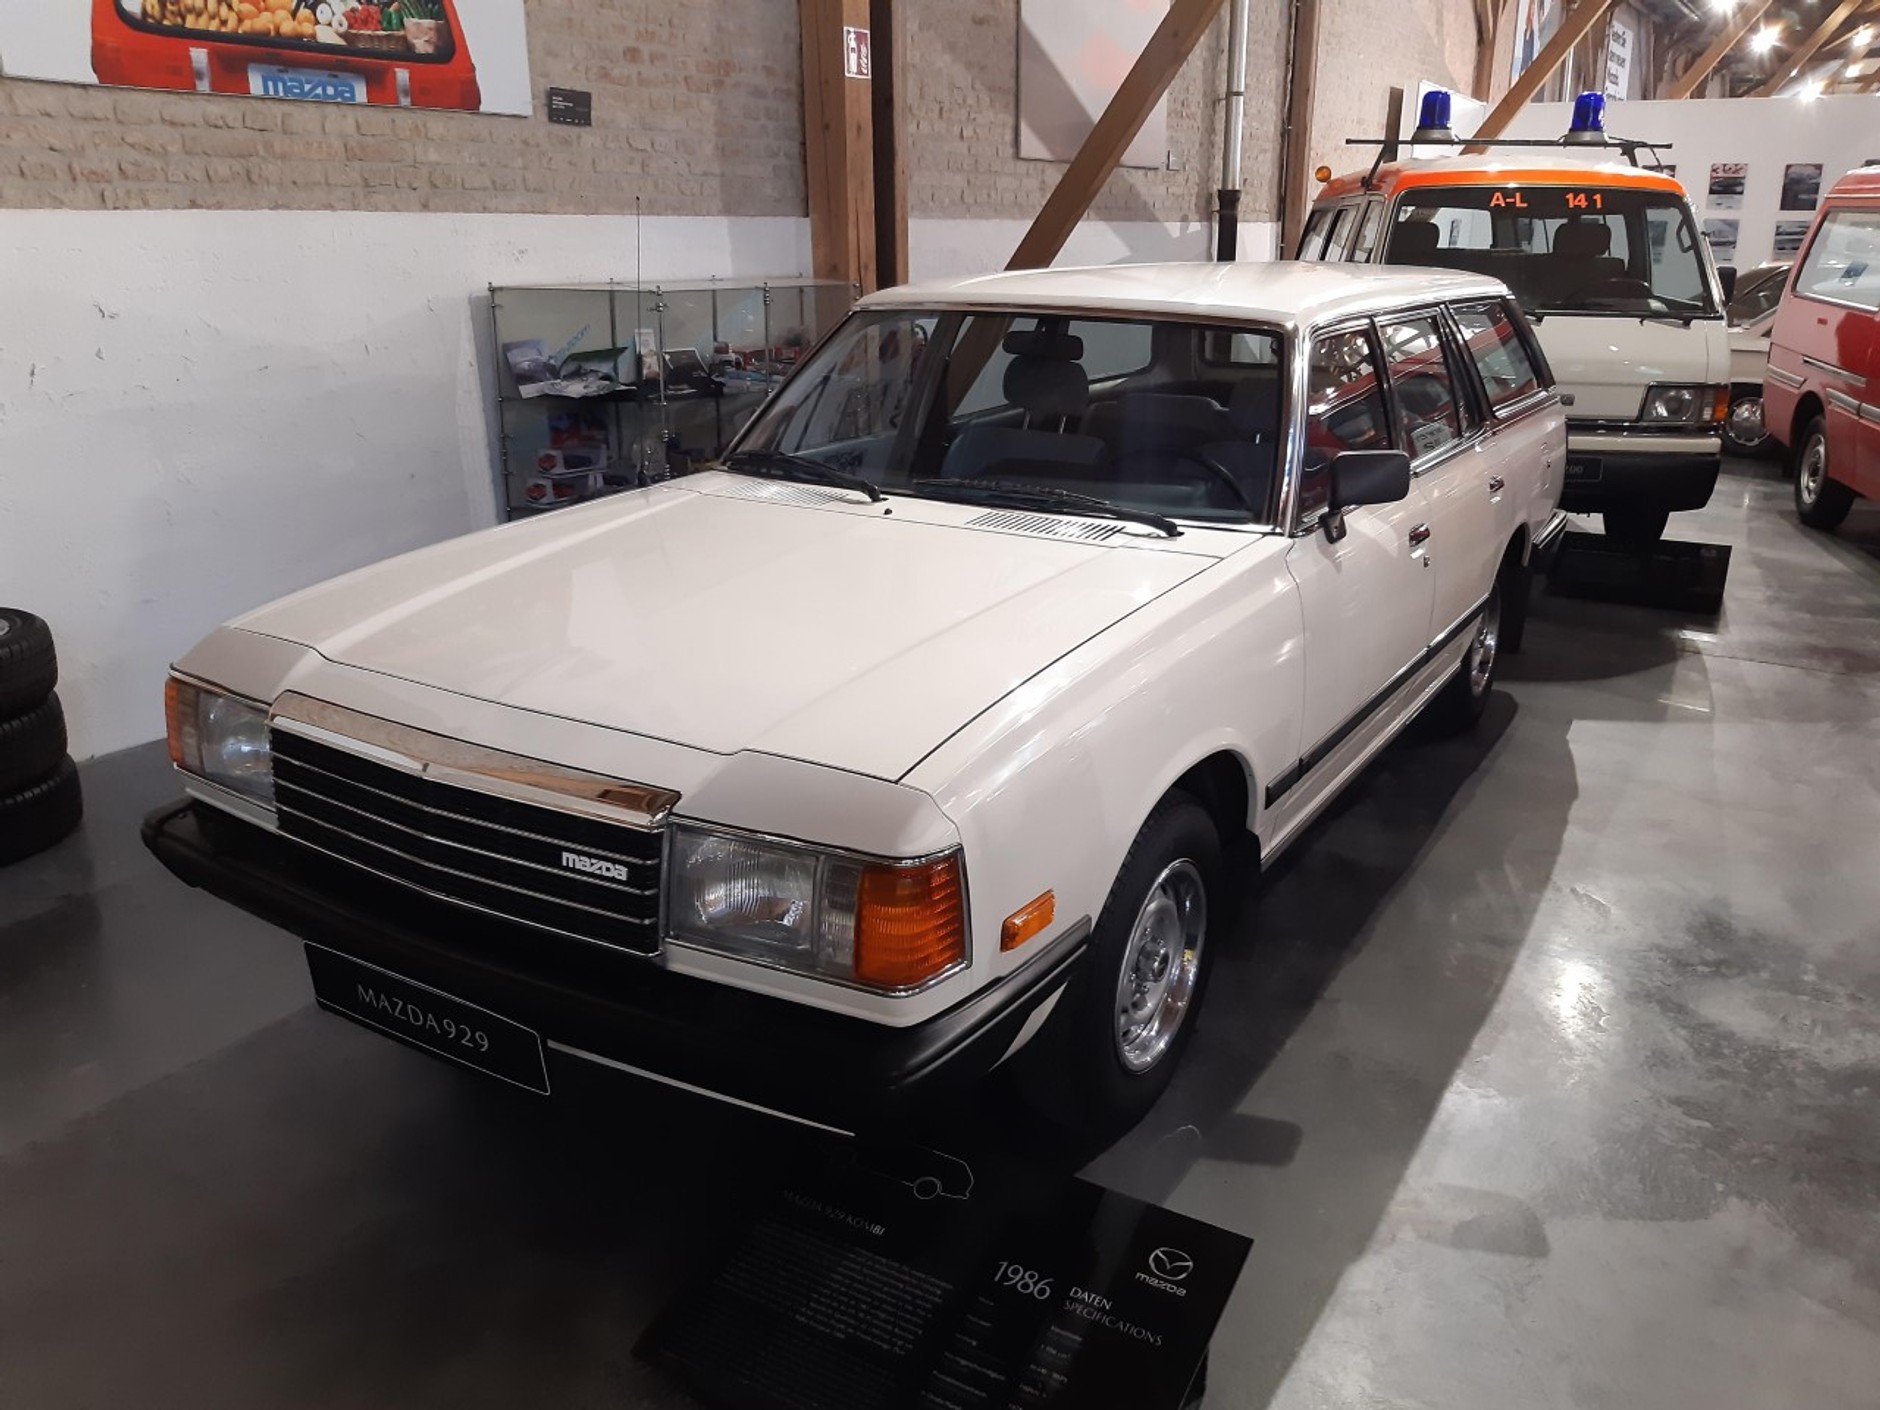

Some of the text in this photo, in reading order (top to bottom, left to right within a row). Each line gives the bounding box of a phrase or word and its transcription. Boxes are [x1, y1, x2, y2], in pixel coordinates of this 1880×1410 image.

[262, 75, 356, 102] mazda
[1489, 192, 1527, 207] A-L
[563, 852, 628, 880] mazda
[995, 1261, 1053, 1300] 1986
[1135, 1271, 1187, 1296] mazda
[1070, 1287, 1112, 1309] DATEN
[1064, 1300, 1162, 1346] SPECIFICATIONS
